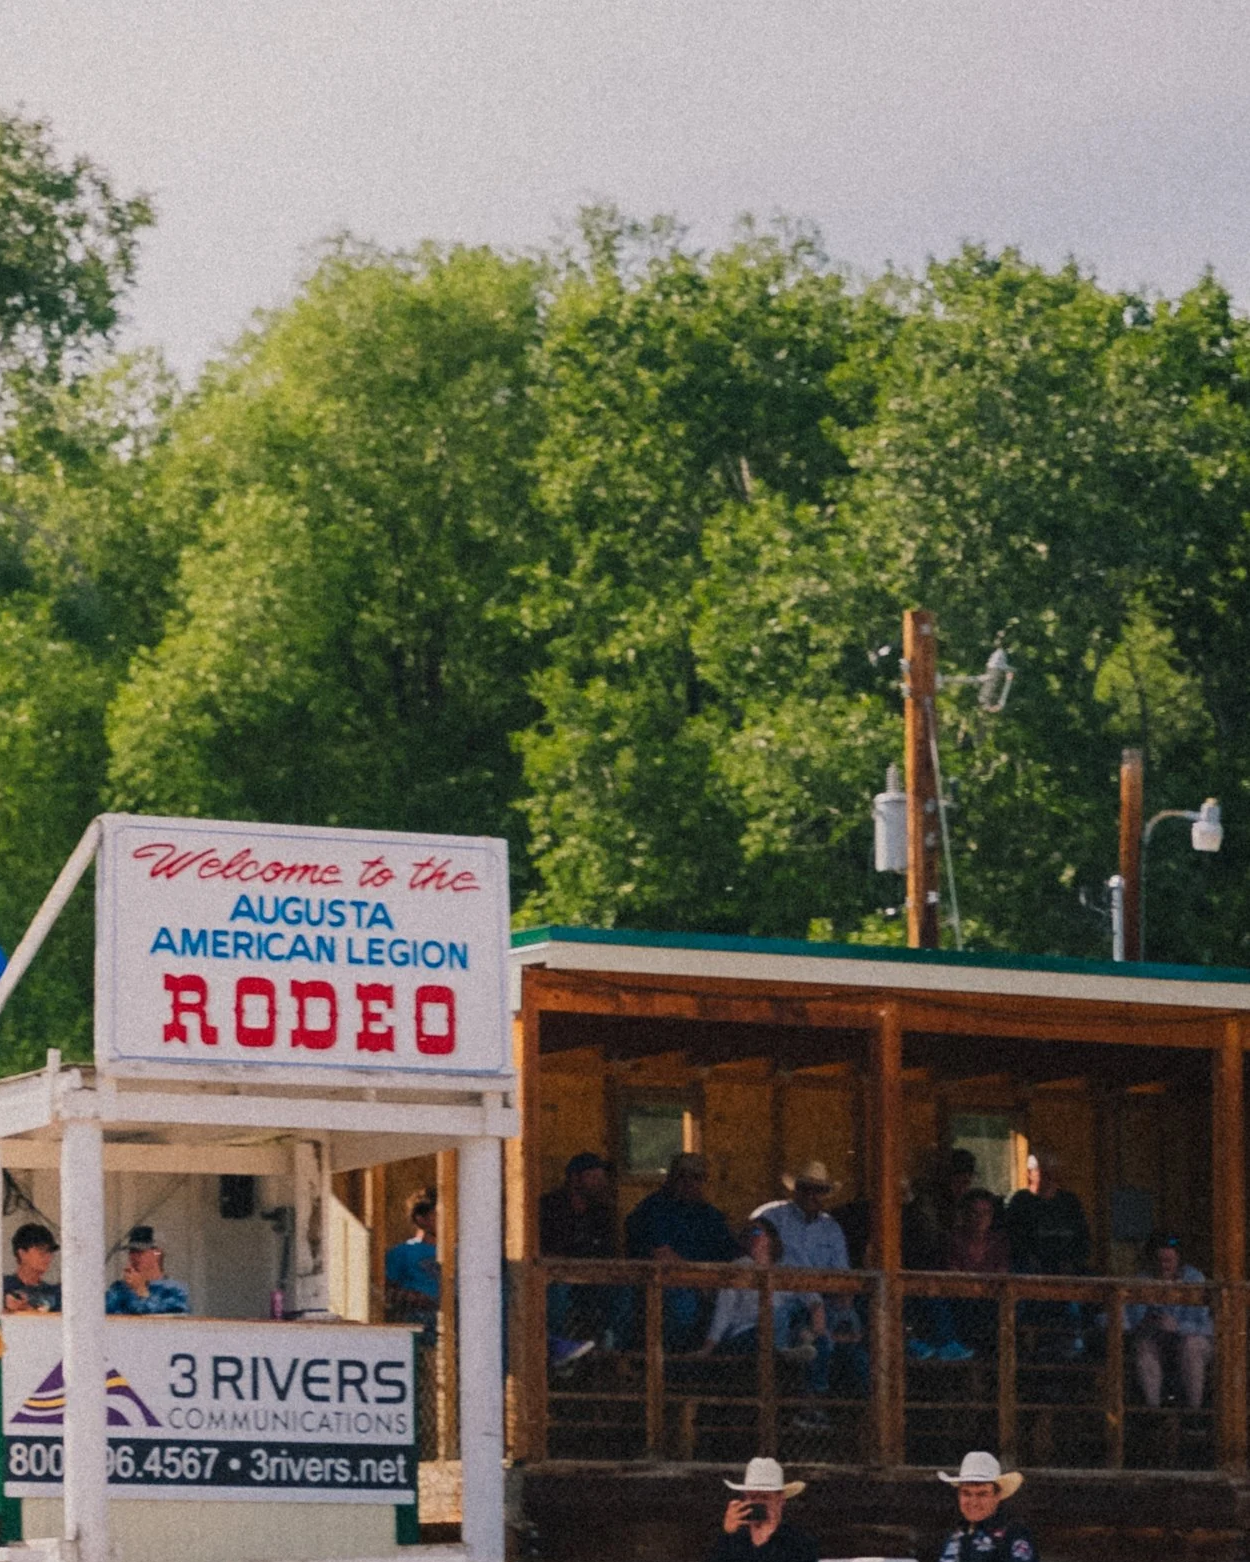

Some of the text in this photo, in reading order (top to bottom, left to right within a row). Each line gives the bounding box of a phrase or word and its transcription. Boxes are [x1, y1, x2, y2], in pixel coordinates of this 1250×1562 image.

[133, 843, 481, 892] Welcome to the
[230, 894, 394, 930] AUGUSTA
[150, 927, 468, 969] AMERICAN LEGION
[163, 973, 456, 1055] RODEO
[169, 1353, 407, 1404] 3 RIVERS
[168, 1408, 408, 1435] COMMUNICATIONS
[250, 1449, 406, 1483] 3rivers.net
